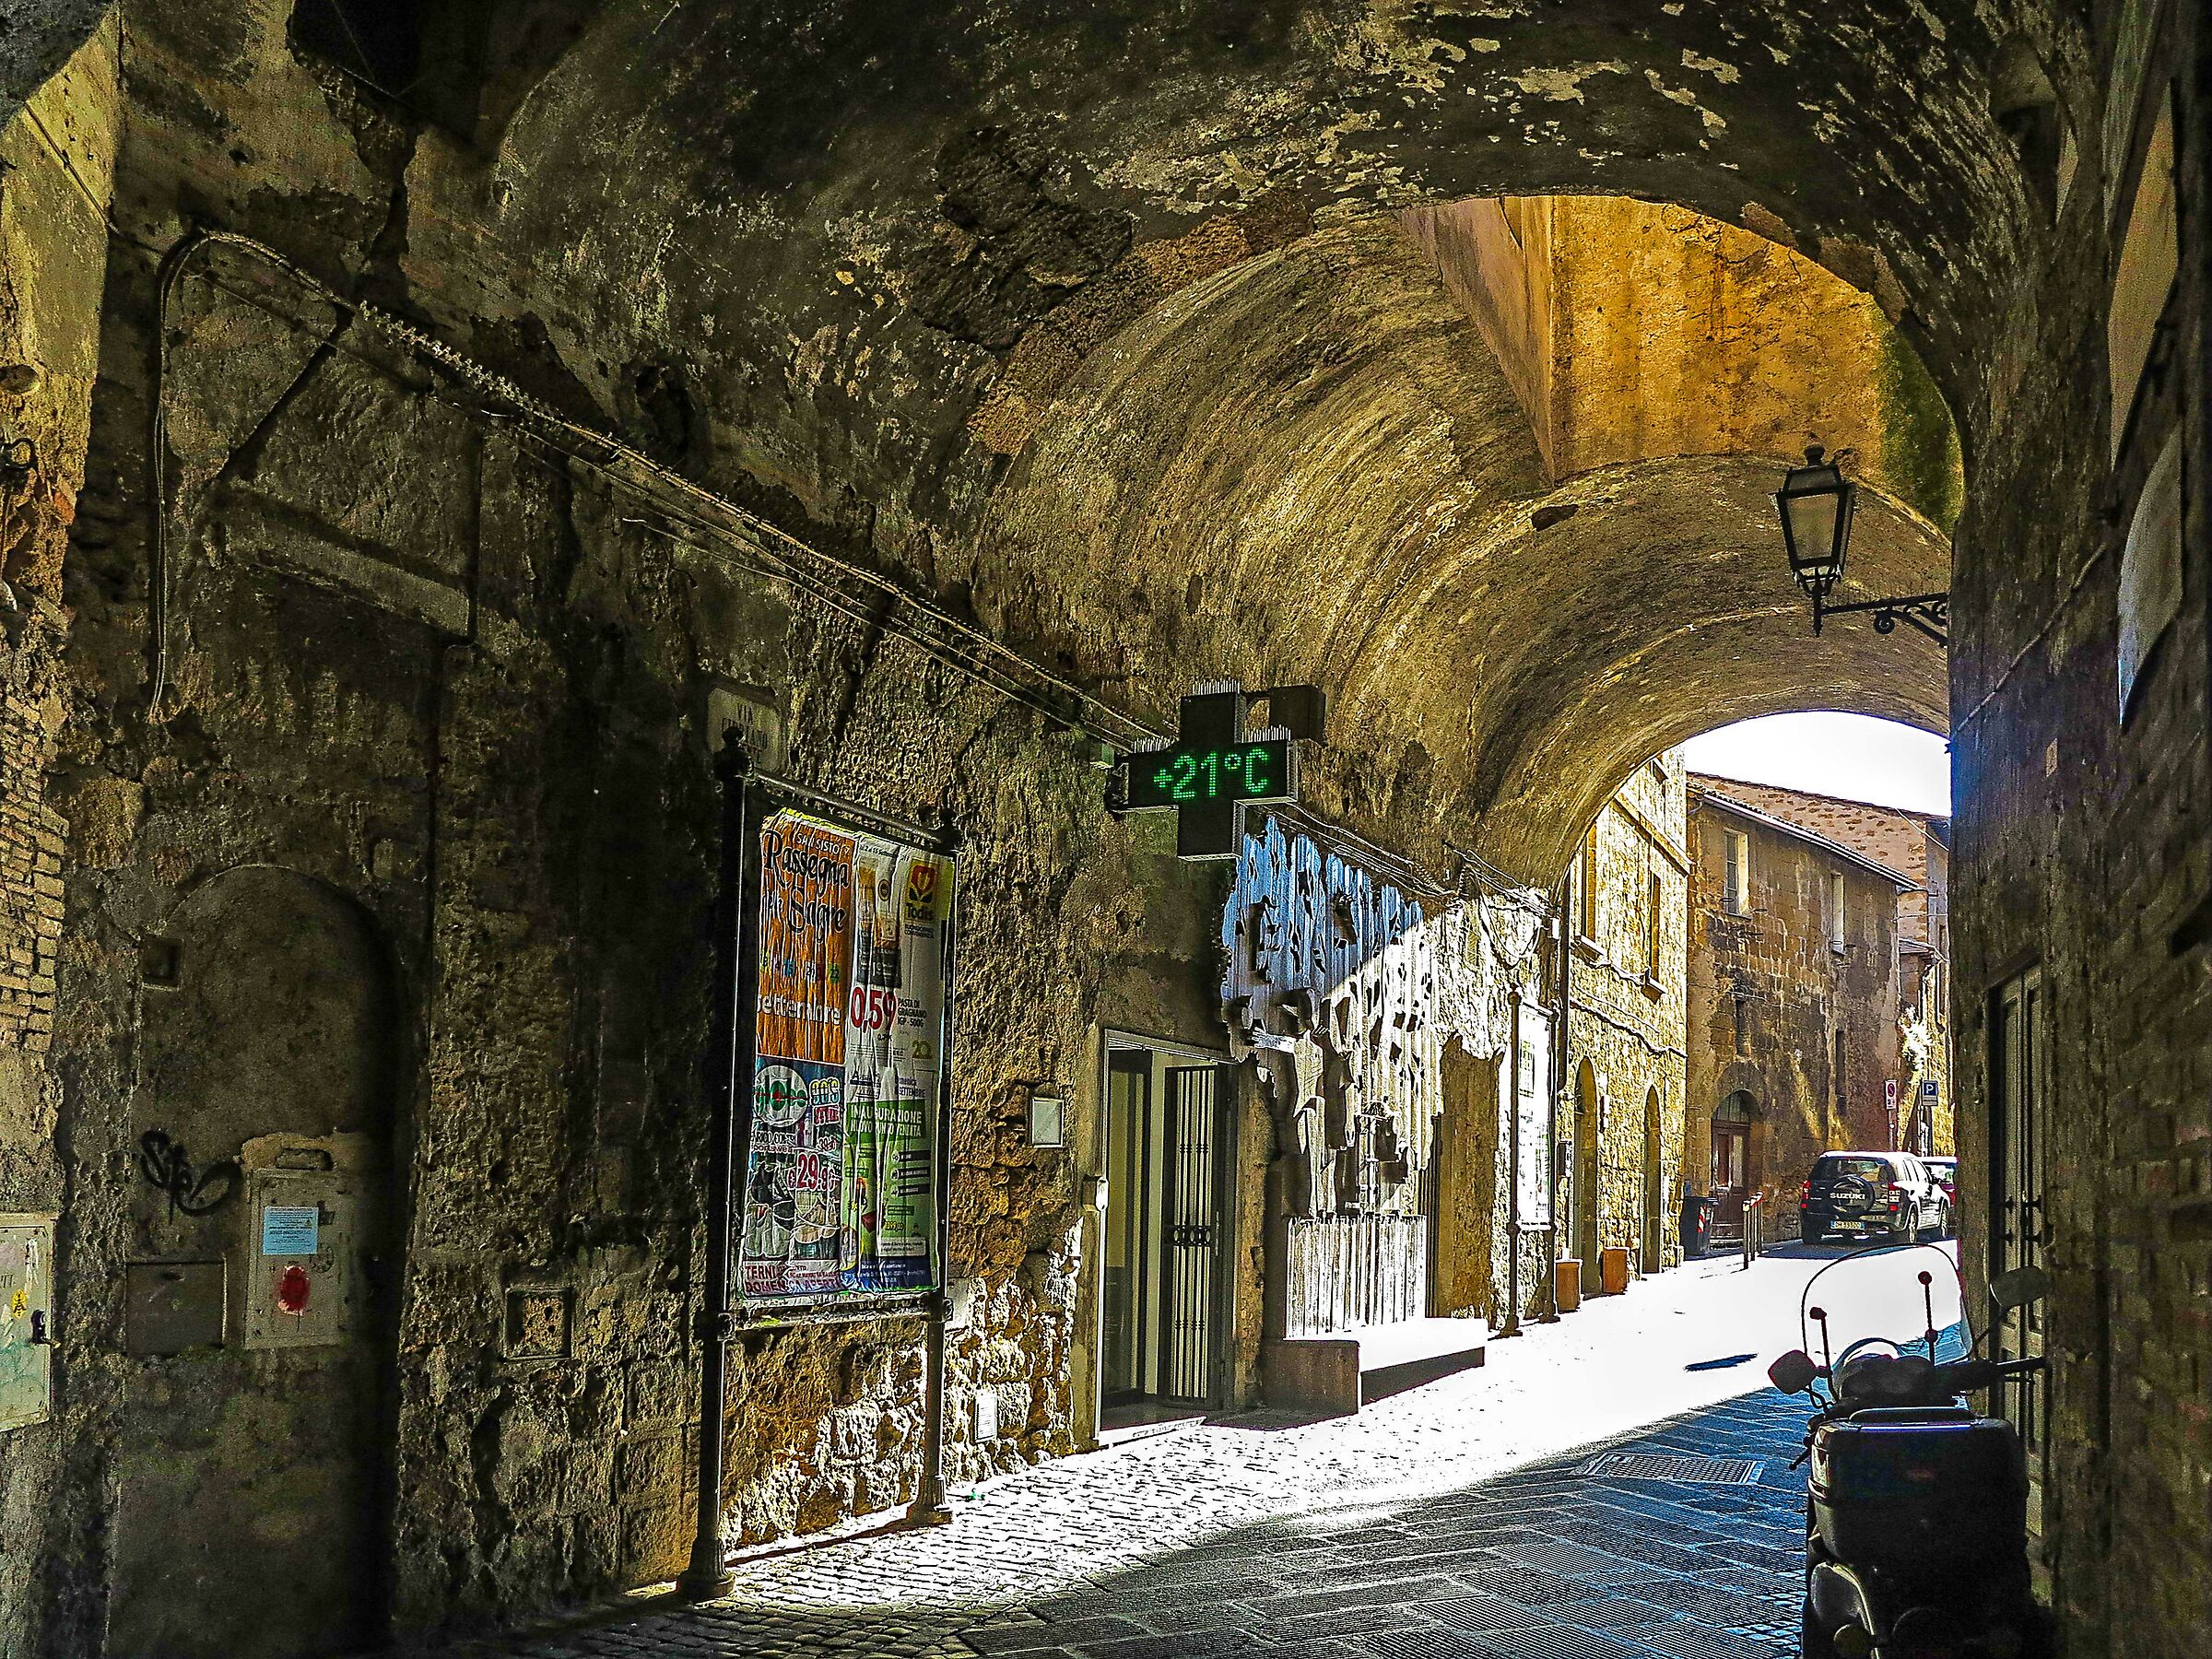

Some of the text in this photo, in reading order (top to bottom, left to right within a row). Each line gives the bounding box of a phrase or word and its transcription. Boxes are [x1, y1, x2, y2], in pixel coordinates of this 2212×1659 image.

[816, 838, 840, 855] SISTO
[762, 829, 850, 900] Rassegna
[851, 986, 897, 1033] 0,59
[898, 998, 914, 1007] PASTA
[1925, 1083, 1935, 1095] P
[851, 1105, 923, 1124] INAUGURAZIONE
[850, 1118, 873, 1134] NUOVO
[1830, 1192, 1865, 1200] SUZUKI
[745, 1265, 775, 1280] TERNI
